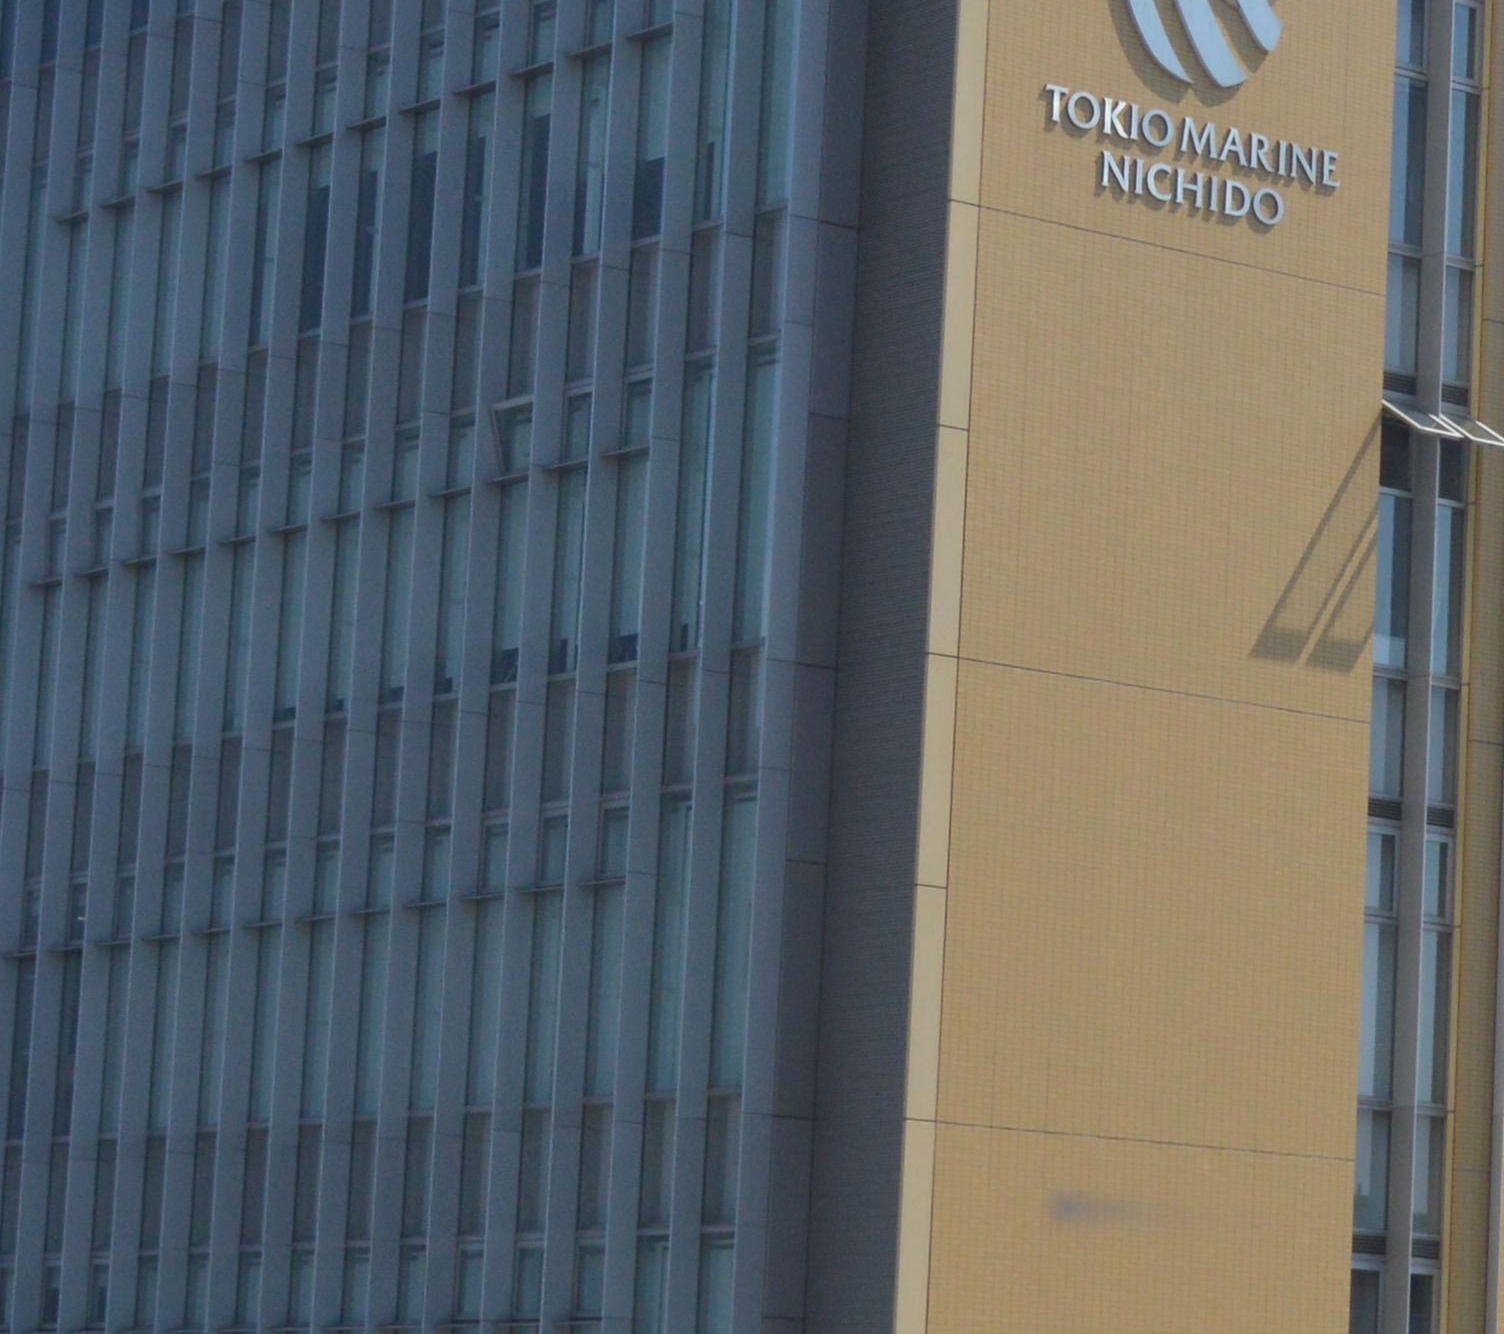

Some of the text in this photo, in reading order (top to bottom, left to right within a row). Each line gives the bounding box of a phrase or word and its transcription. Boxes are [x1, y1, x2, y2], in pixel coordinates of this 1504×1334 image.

[1045, 82, 1340, 188] TOKIO MARINE
[1099, 150, 1285, 226] NICHIDO
